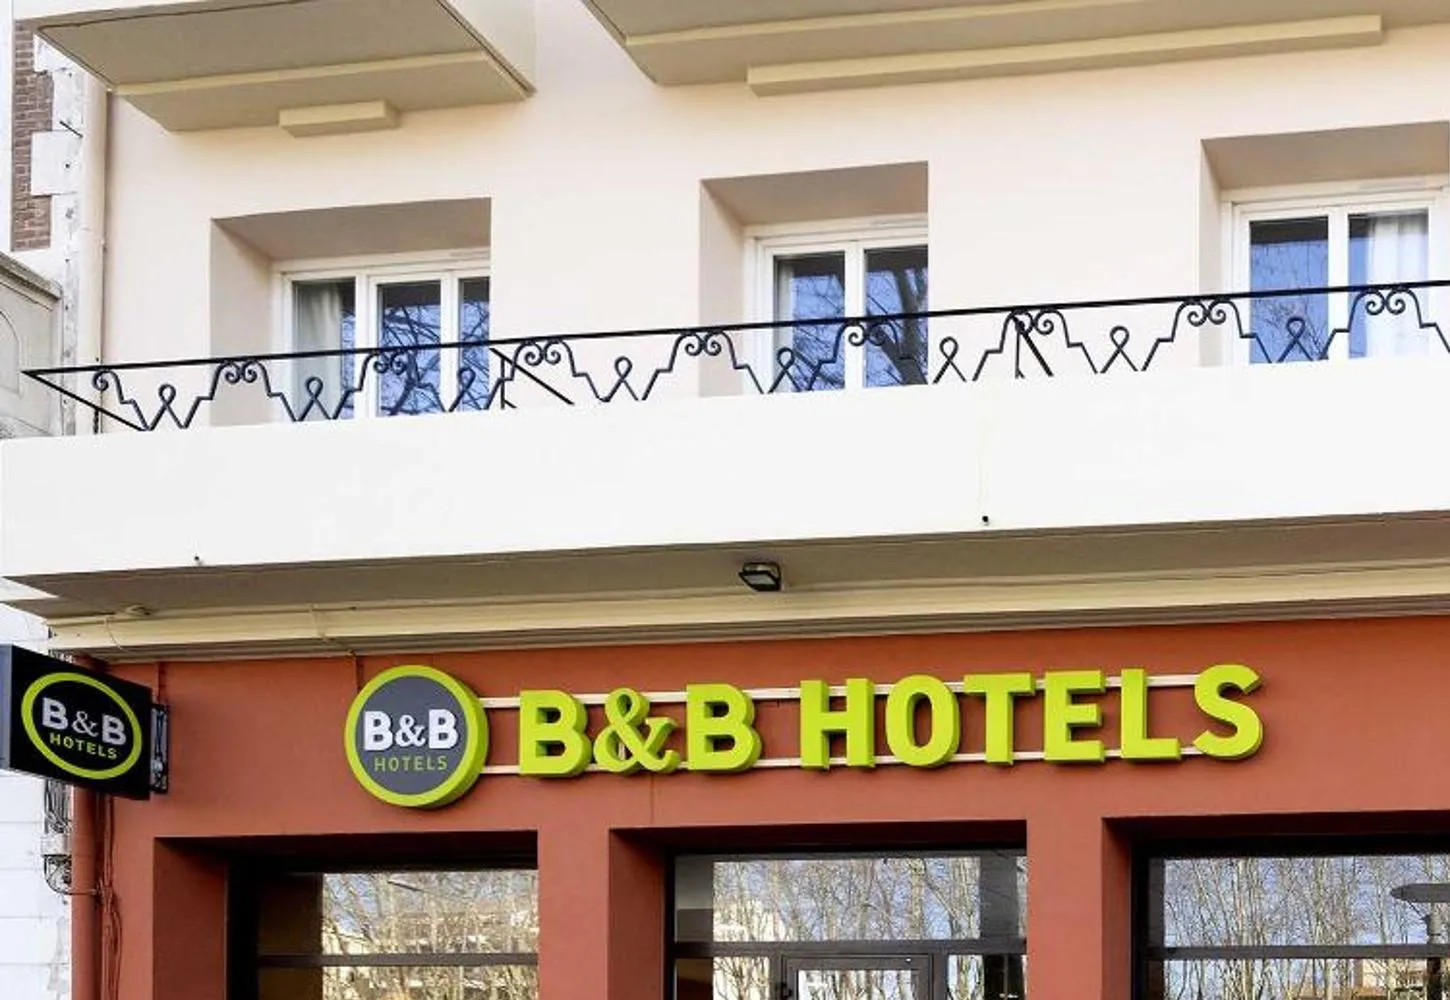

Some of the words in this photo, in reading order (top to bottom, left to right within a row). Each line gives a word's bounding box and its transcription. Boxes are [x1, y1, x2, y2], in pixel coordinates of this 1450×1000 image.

[42, 697, 126, 745] B&B
[364, 709, 459, 751] B&B
[519, 683, 763, 775] B&B
[800, 664, 1263, 770] HOTELS
[49, 732, 117, 760] HOTELS
[374, 755, 447, 772] HOTELS
